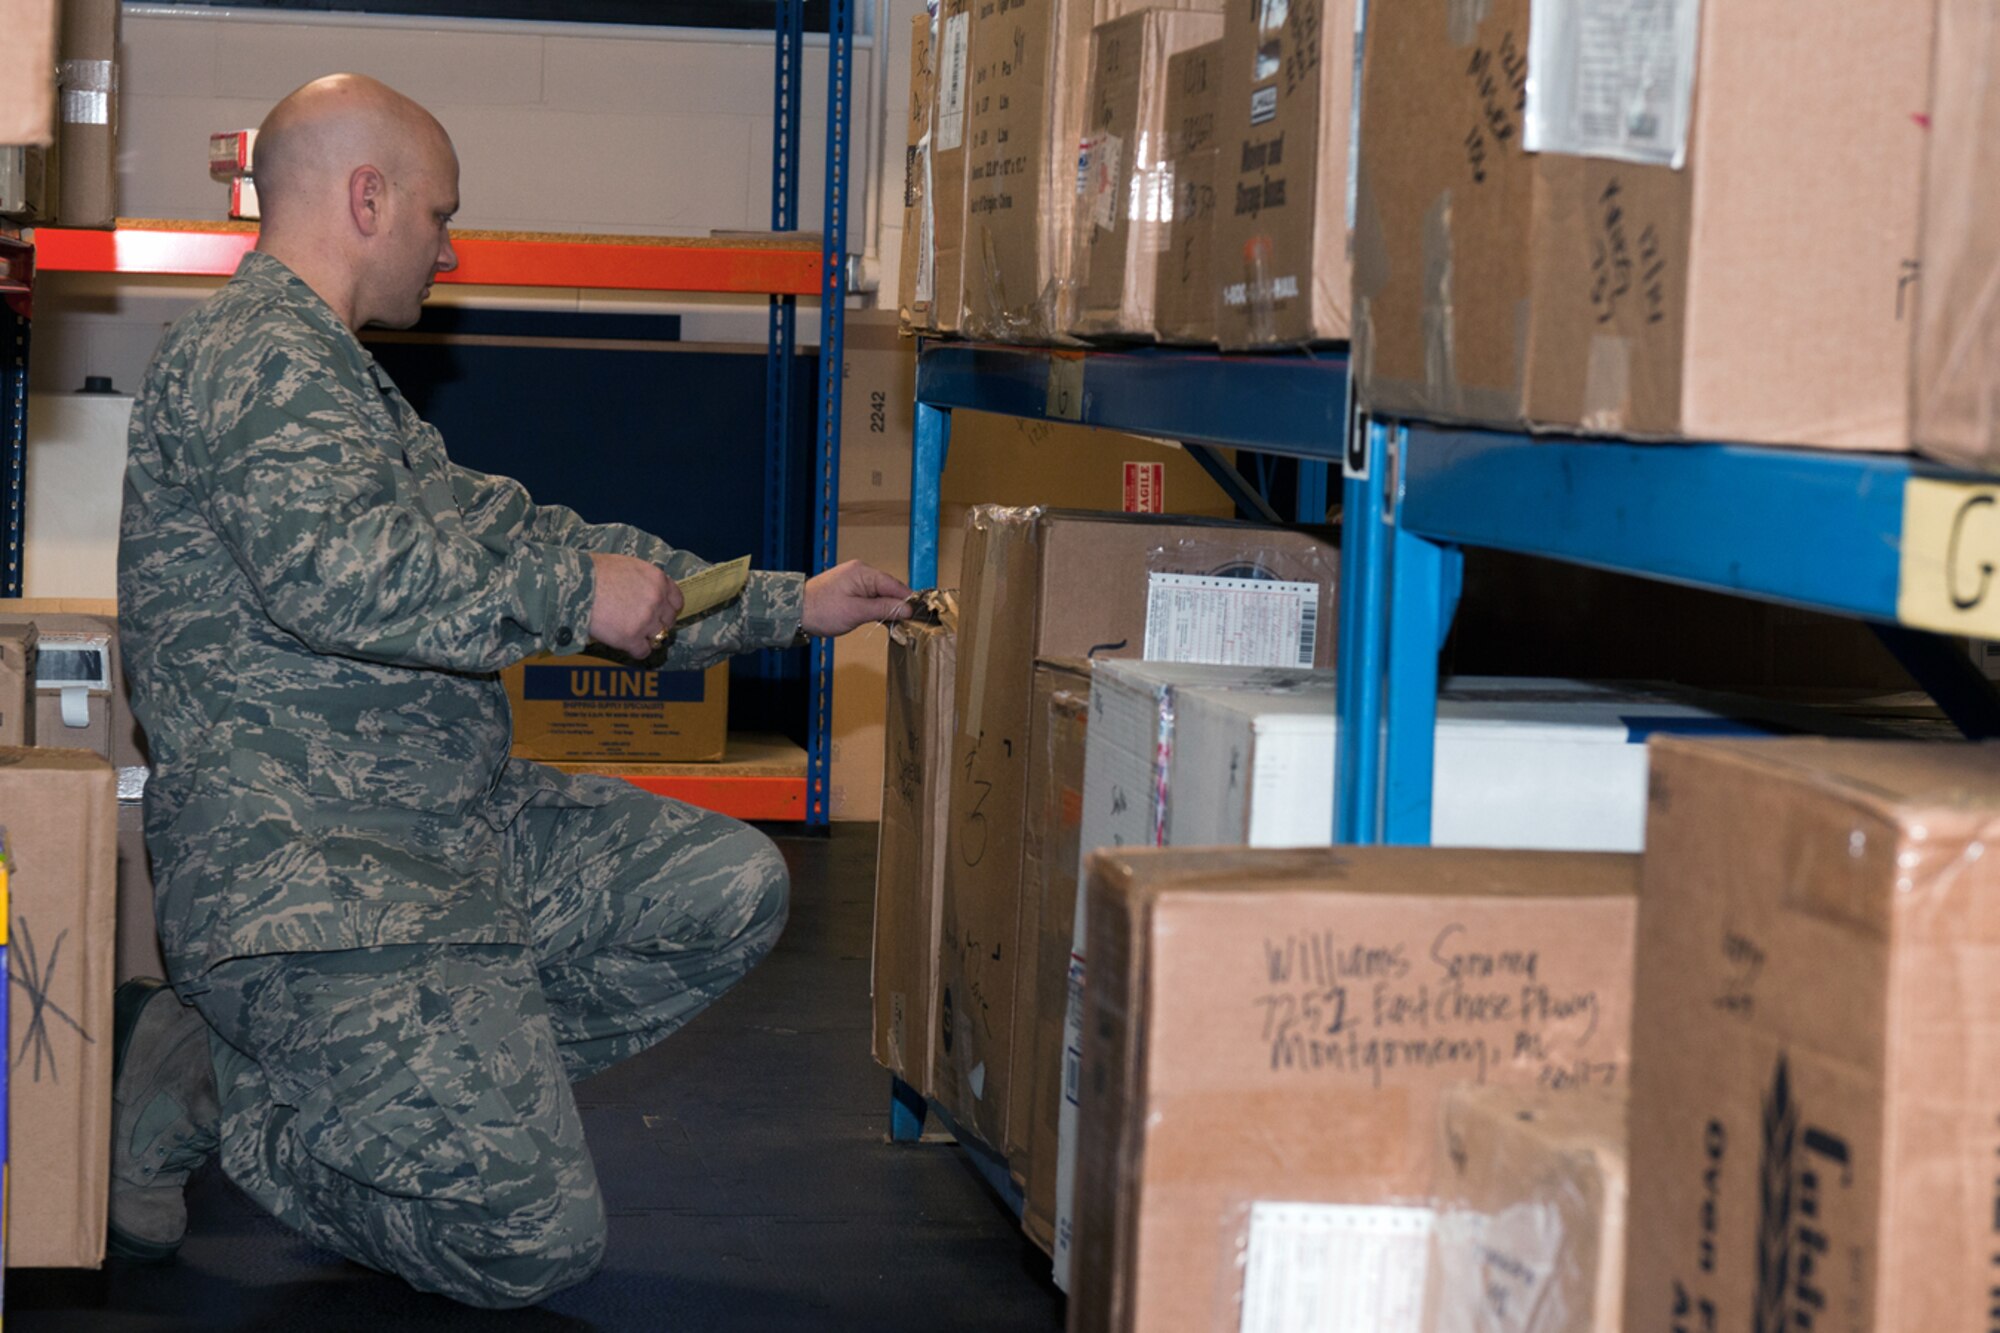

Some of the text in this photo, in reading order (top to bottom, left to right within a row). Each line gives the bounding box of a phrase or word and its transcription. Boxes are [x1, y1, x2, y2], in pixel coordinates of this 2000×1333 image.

[870, 391, 886, 433] 2242
[570, 670, 660, 698] ULINE
[1262, 928, 1410, 986] Williams
